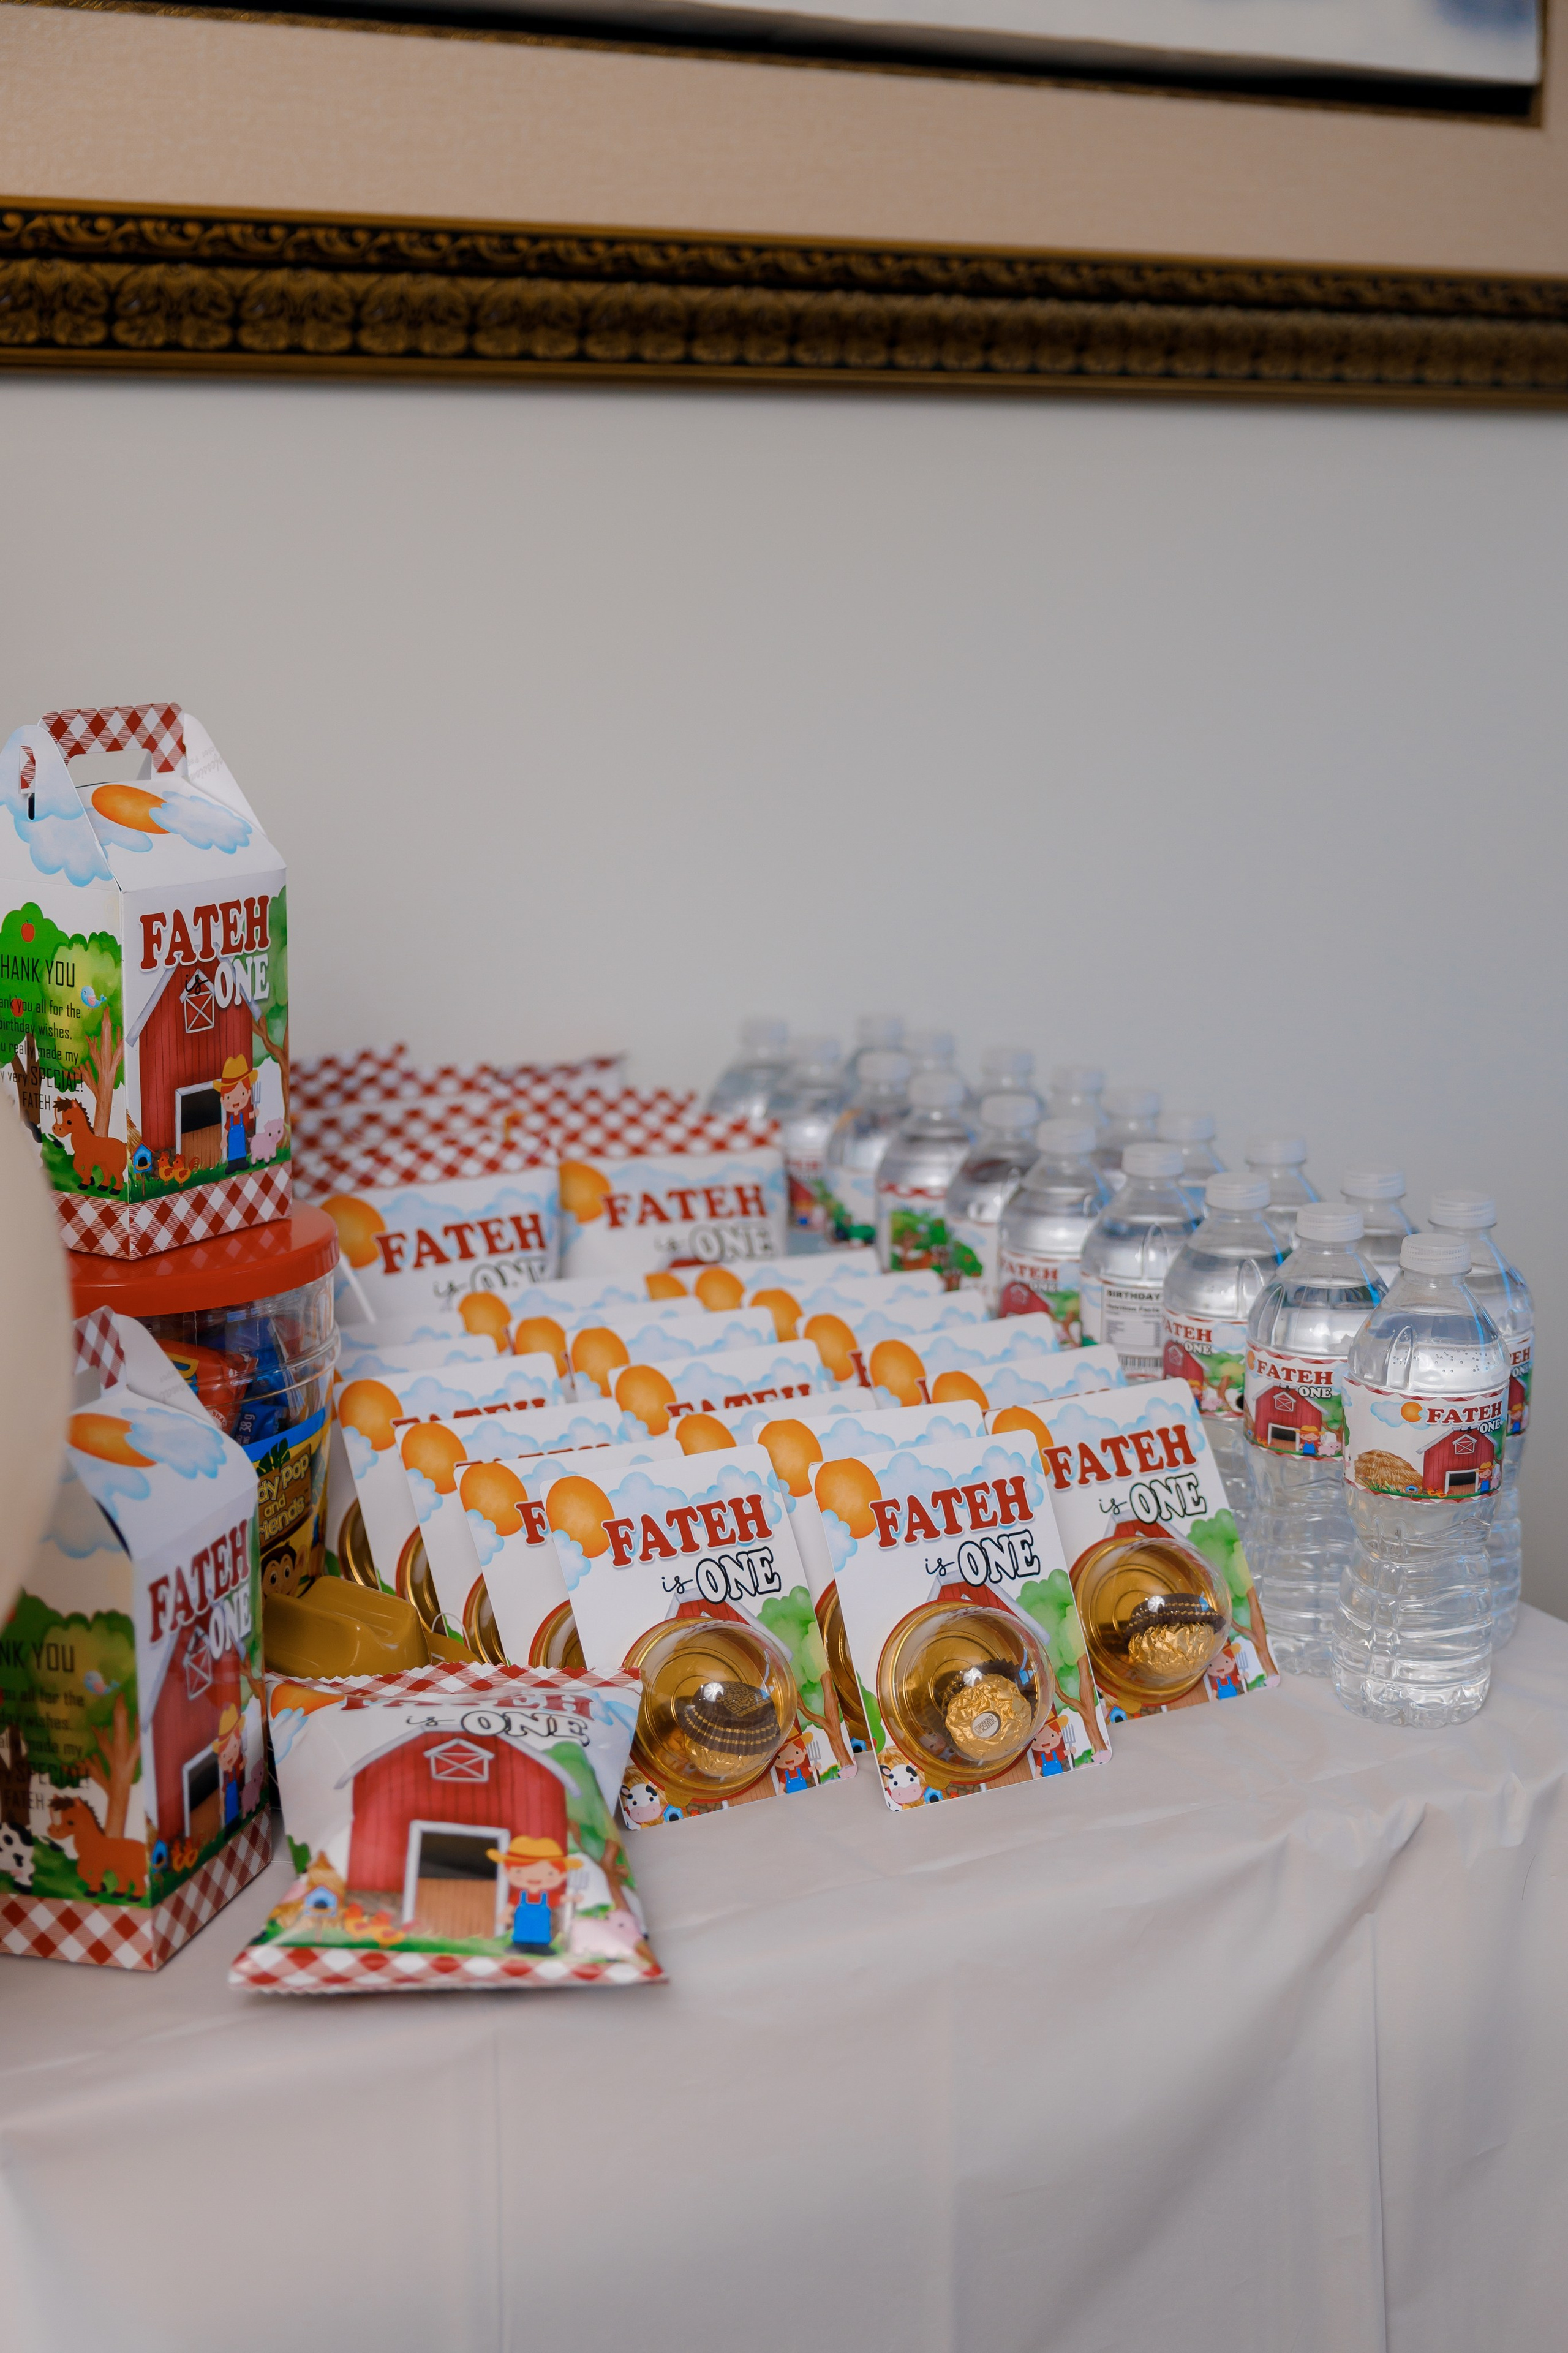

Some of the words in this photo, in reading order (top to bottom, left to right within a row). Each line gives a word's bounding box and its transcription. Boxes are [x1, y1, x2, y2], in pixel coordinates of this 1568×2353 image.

[140, 895, 270, 970] FATEH
[0, 954, 40, 983] HANK
[45, 959, 75, 988] YOU
[185, 974, 209, 995] is
[214, 953, 270, 1008] ONE
[0, 994, 14, 1010] ank
[17, 1000, 32, 1014] you
[36, 999, 46, 1014] all
[50, 999, 63, 1016] for
[66, 1002, 81, 1019] the
[38, 1022, 72, 1040] wishes.
[9, 1040, 34, 1059] really
[39, 1044, 62, 1060] made
[66, 1051, 78, 1065] my
[8, 1071, 28, 1087] very
[31, 1065, 83, 1092] SPECIAL!
[23, 1091, 51, 1111] FATEH
[603, 1184, 767, 1229] FATEH
[375, 1214, 546, 1274] FATEH
[688, 1224, 774, 1264] ONE
[1107, 1290, 1161, 1301] BIRTHDAY
[1165, 1319, 1212, 1343] ATEH
[1183, 1340, 1212, 1356] ONE
[1257, 1359, 1333, 1385] FATEH
[1298, 1385, 1332, 1399] ONE
[211, 1411, 227, 1427] SNAC
[239, 1421, 252, 1433] 38
[1427, 1400, 1502, 1423] FATEH
[1479, 1417, 1501, 1434] ONE
[1043, 1424, 1197, 1490] FATEH
[257, 1476, 279, 1504] dy
[281, 1454, 309, 1490] pop
[264, 1494, 286, 1517] and
[870, 1475, 1033, 1548] FATEH
[1099, 1498, 1127, 1515] is
[1129, 1472, 1207, 1525] ONE
[260, 1496, 305, 1541] iends
[602, 1494, 772, 1566] FATEH
[925, 1558, 955, 1576] is
[957, 1529, 1041, 1587] ONE
[148, 1518, 249, 1643] FATEH
[662, 1575, 693, 1594] is
[696, 1546, 782, 1604] ONE
[208, 1584, 252, 1660] ONE
[32, 1642, 75, 1673] YOU
[405, 1715, 456, 1726] is
[461, 1710, 590, 1747] ONE
[973, 1715, 993, 1732] FERRERO
